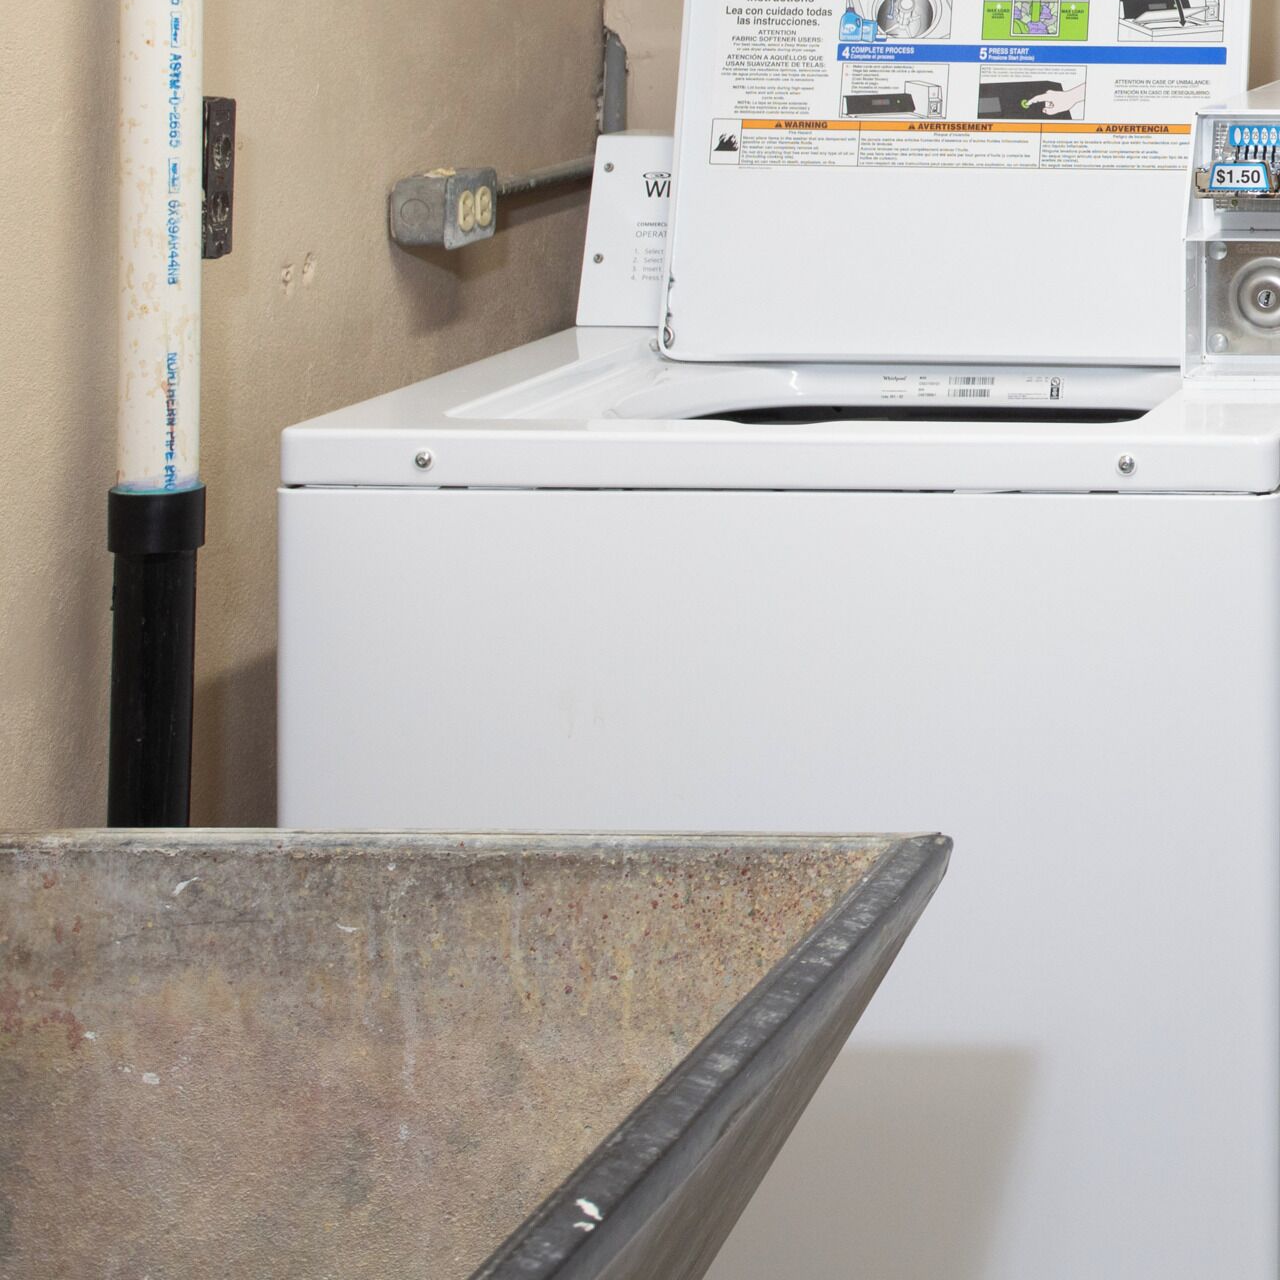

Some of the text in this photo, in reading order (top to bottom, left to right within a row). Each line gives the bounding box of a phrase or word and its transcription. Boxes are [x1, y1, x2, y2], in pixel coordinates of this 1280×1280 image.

[725, 5, 833, 17] Lea con cuidado todas
[736, 16, 821, 26] las instrucciones.
[841, 46, 851, 59] 4
[979, 47, 988, 60] 5
[988, 47, 1009, 55] PRESS
[784, 121, 828, 129] WARNING
[918, 123, 994, 131] AVERTISSEMENT
[1105, 125, 1169, 133] ADVERTENCIA
[1216, 169, 1261, 184] $1.50
